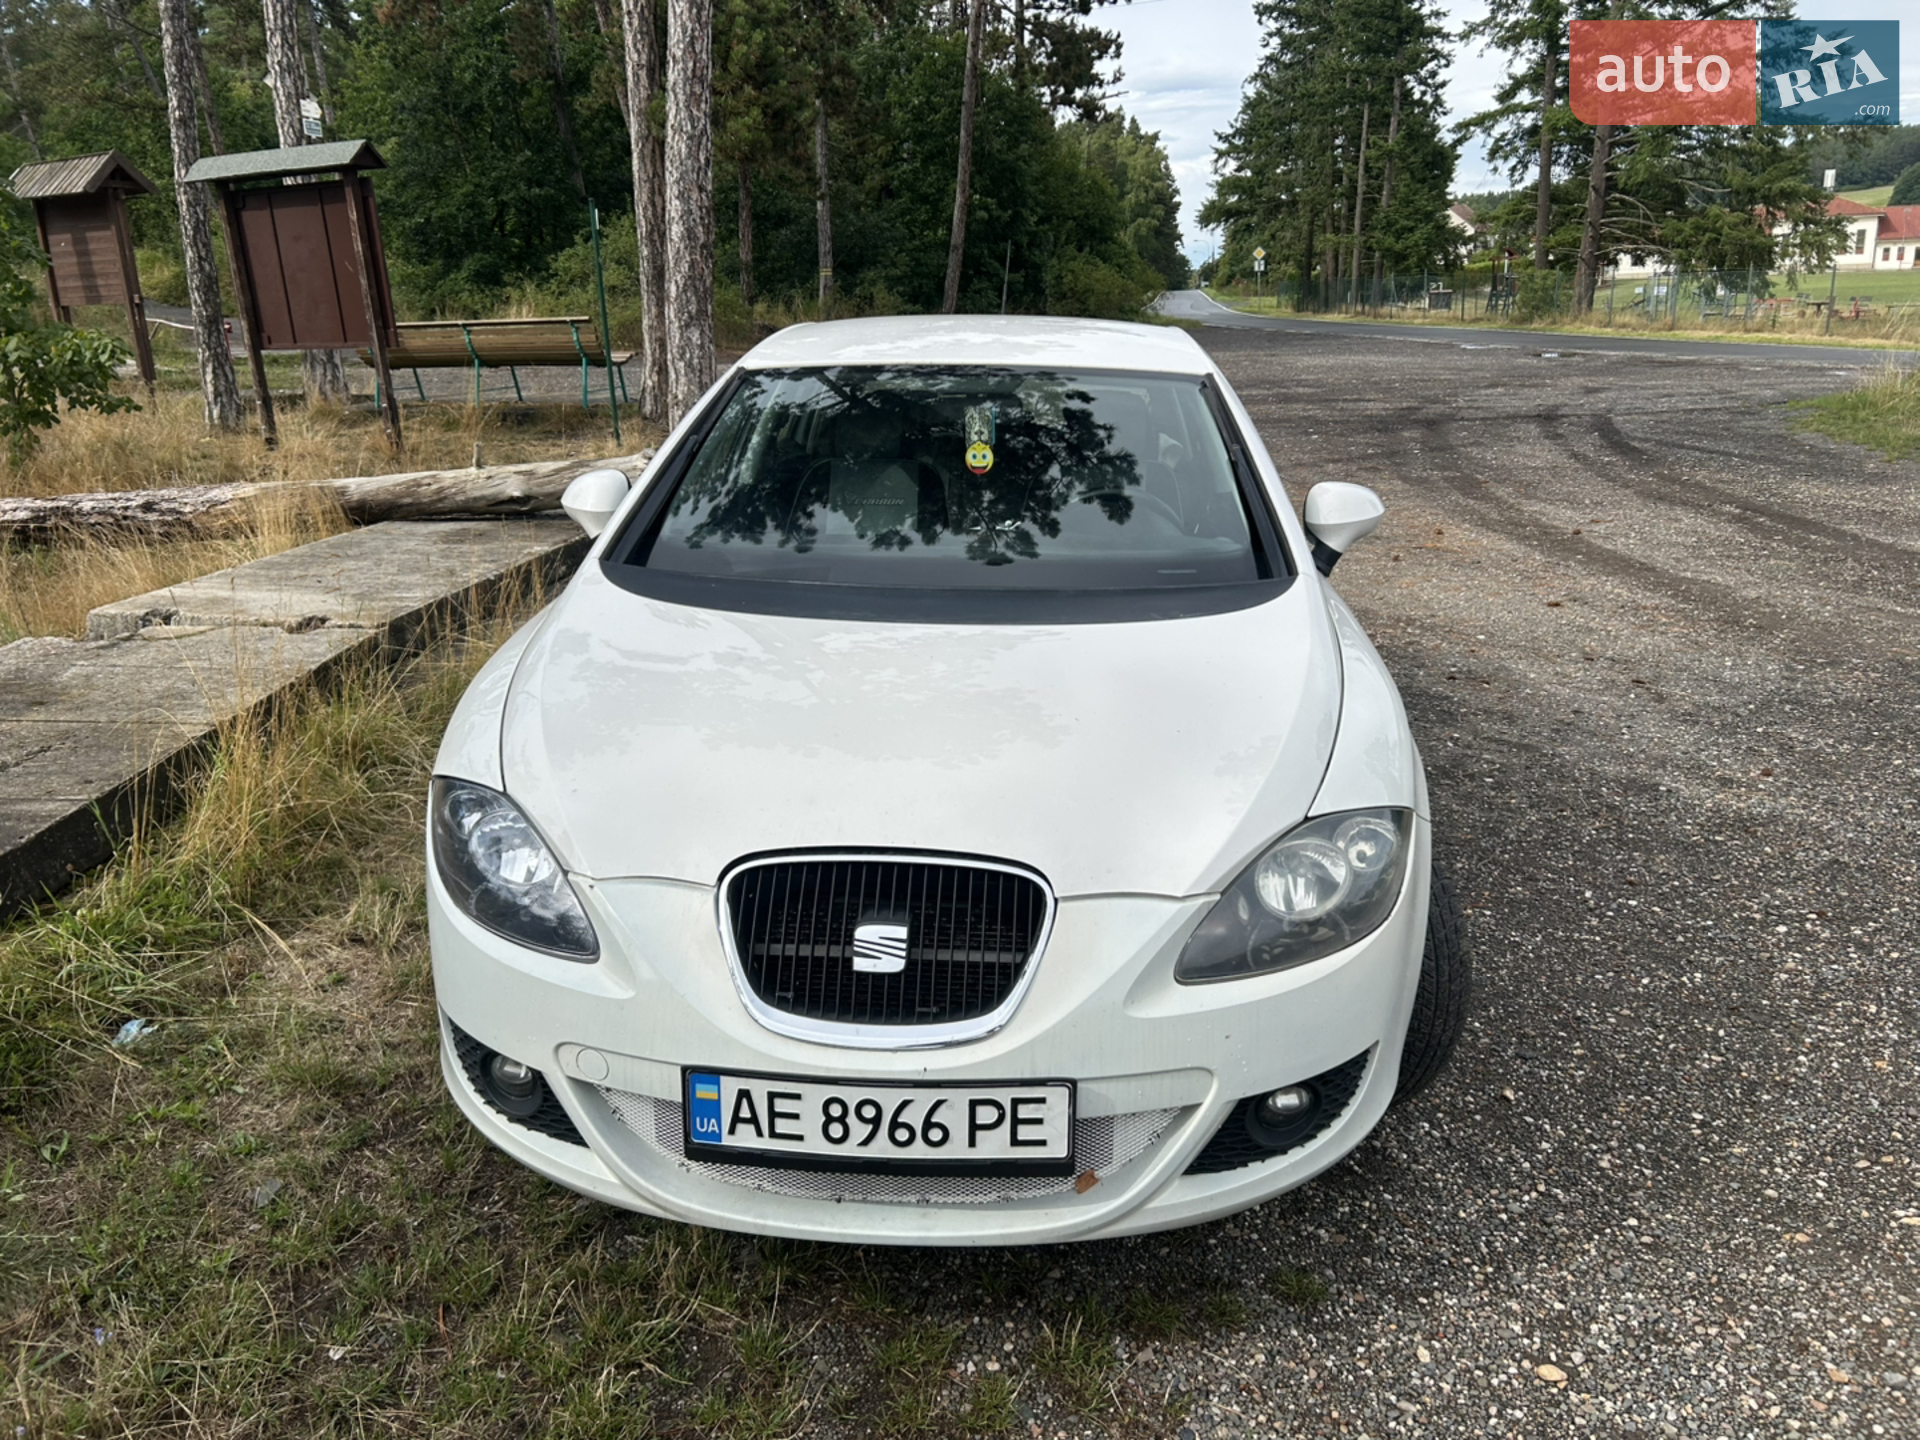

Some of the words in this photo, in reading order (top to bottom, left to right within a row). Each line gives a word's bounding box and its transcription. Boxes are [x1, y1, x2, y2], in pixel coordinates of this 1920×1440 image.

[695, 1116, 720, 1133] UA
[727, 1088, 805, 1142] AE
[821, 1096, 950, 1148] 8966
[967, 1096, 1048, 1149] PE
